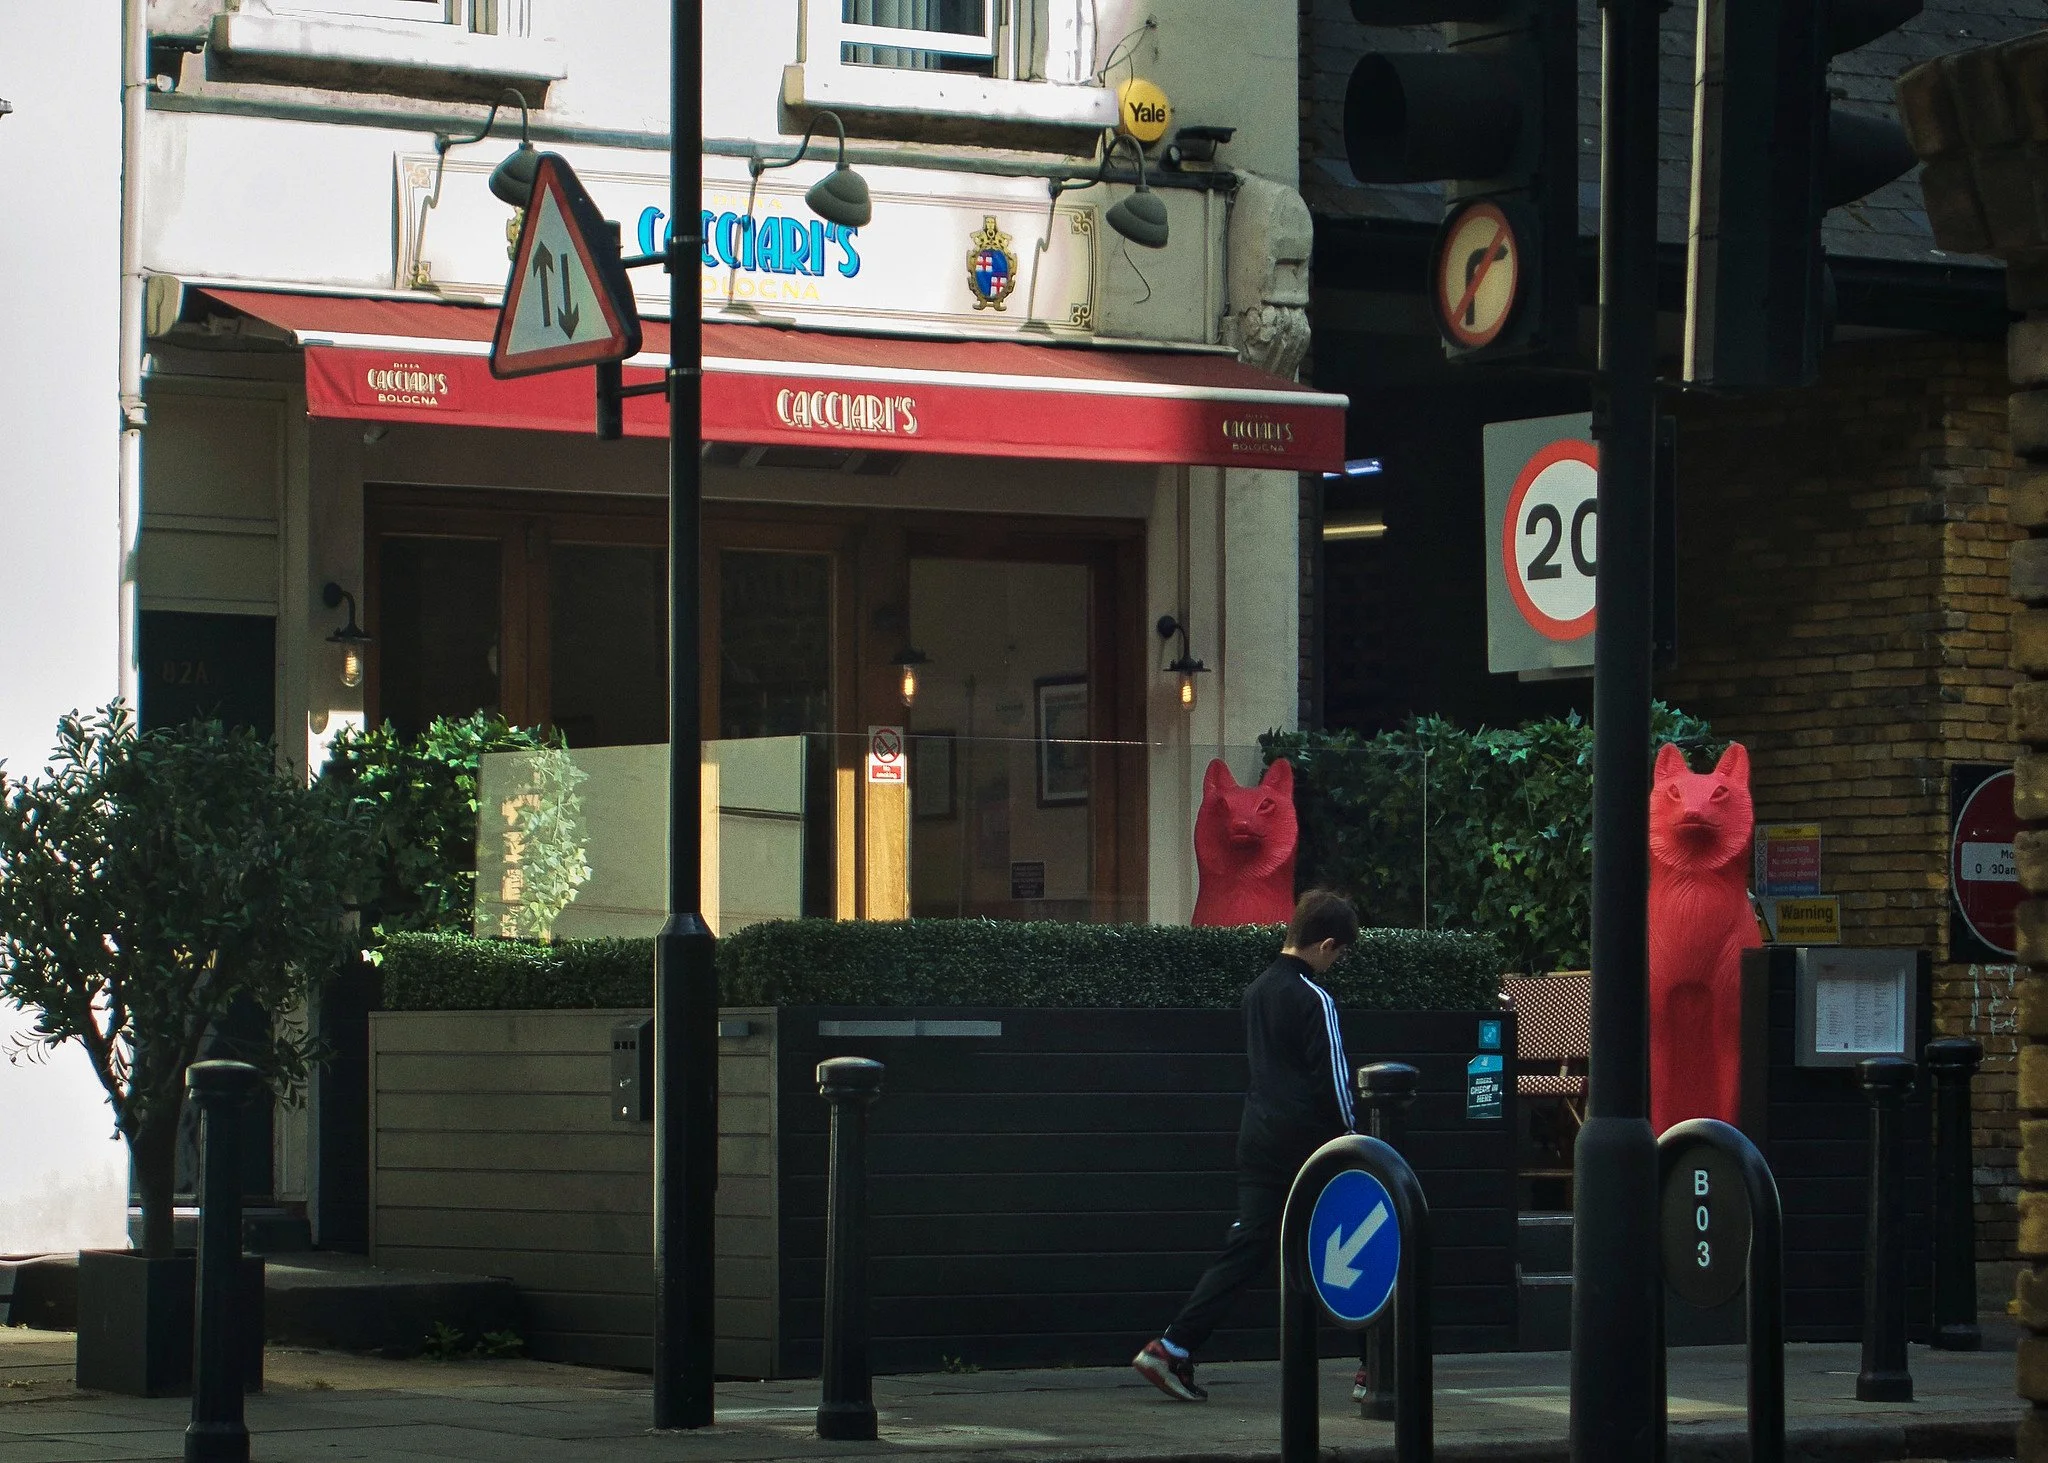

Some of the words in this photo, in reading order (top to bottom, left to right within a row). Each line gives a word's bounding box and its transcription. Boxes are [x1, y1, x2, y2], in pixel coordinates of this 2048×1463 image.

[1129, 102, 1165, 122] Yale
[638, 206, 861, 278] CCCIARI'S
[702, 275, 820, 300] OLOGNA
[367, 368, 448, 395] CACCIARI'S
[378, 393, 438, 405] BOLOGNA
[776, 388, 918, 435] CACCIARI'S
[1222, 419, 1294, 442] CACCIARI'S
[1232, 442, 1284, 452] BOLOGNA
[1525, 498, 1597, 581] 20
[1781, 903, 1834, 923] Warning
